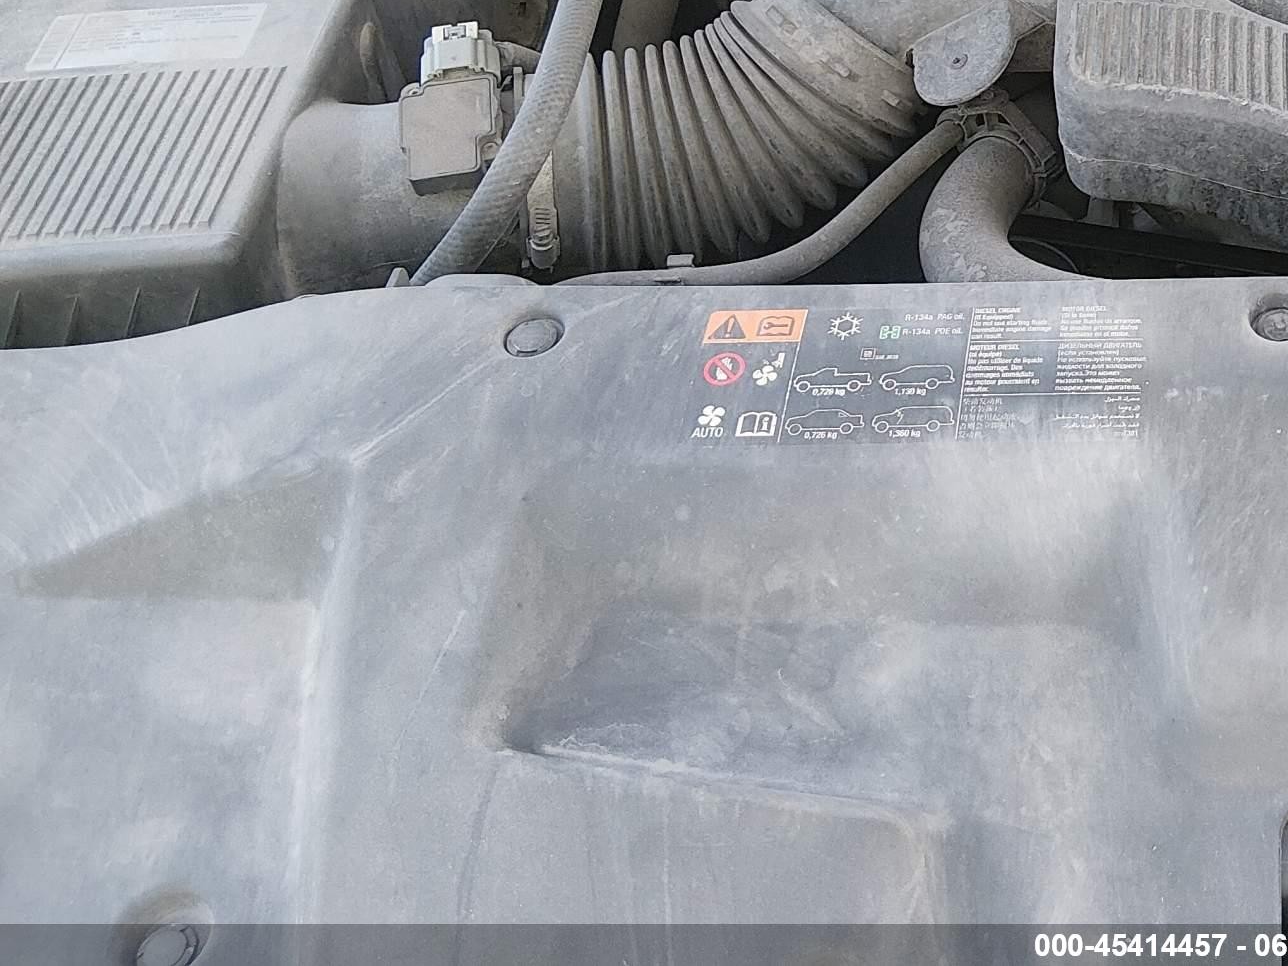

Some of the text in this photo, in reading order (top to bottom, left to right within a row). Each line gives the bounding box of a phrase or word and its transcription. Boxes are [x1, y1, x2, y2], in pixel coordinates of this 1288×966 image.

[905, 313, 934, 321] R-134a
[835, 388, 845, 396] kg
[915, 388, 926, 396] kg
[690, 426, 724, 438] AUTO
[827, 431, 838, 439] kg
[911, 429, 920, 437] kg
